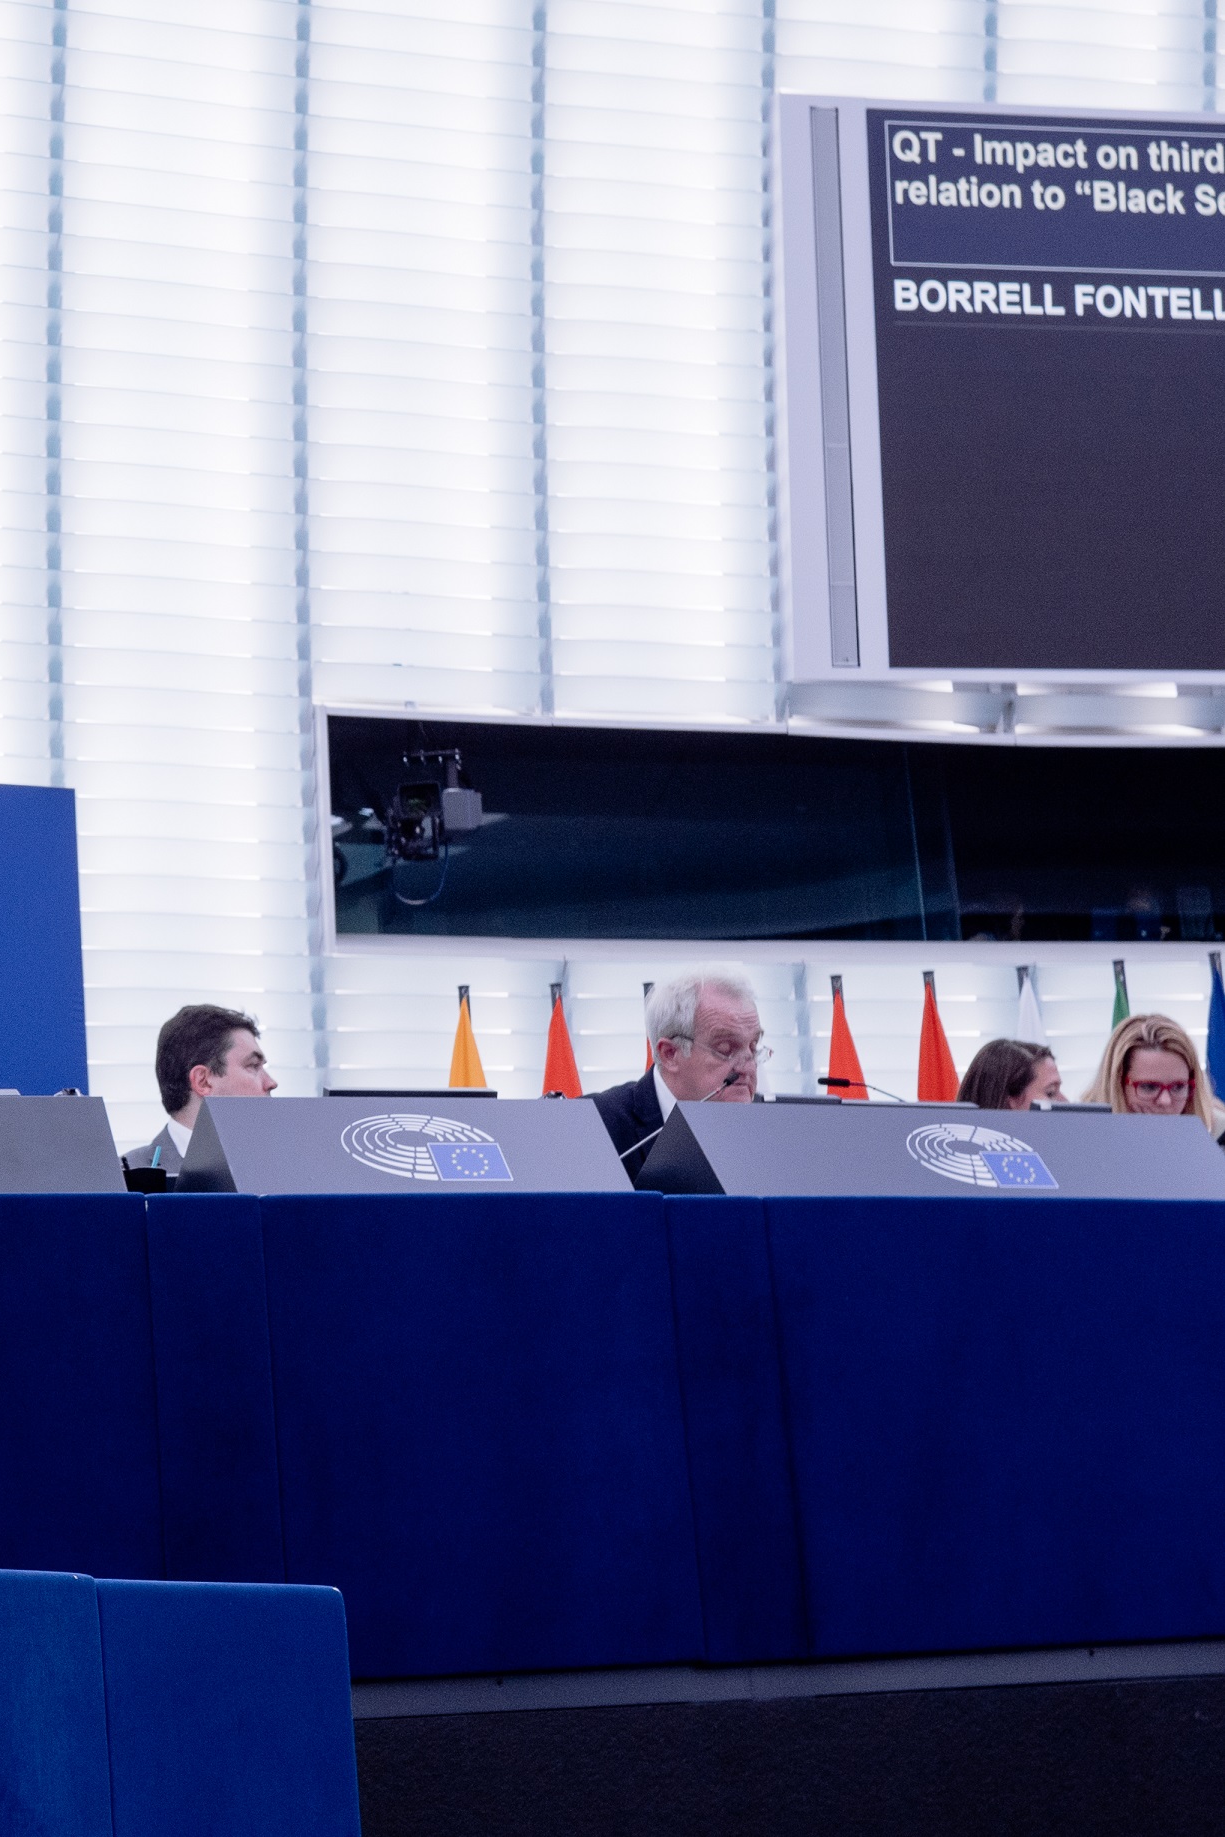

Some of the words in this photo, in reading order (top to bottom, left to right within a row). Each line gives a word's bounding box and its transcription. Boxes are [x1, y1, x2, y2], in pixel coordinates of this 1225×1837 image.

[892, 130, 942, 164] QT
[953, 148, 965, 157] -
[974, 133, 1088, 173] Impact
[1096, 144, 1138, 171] on
[1147, 140, 1225, 174] third
[894, 174, 1022, 209] relation
[1031, 179, 1066, 210] to
[893, 278, 1066, 316] BORRELL
[1074, 284, 1225, 321] FONTELL
